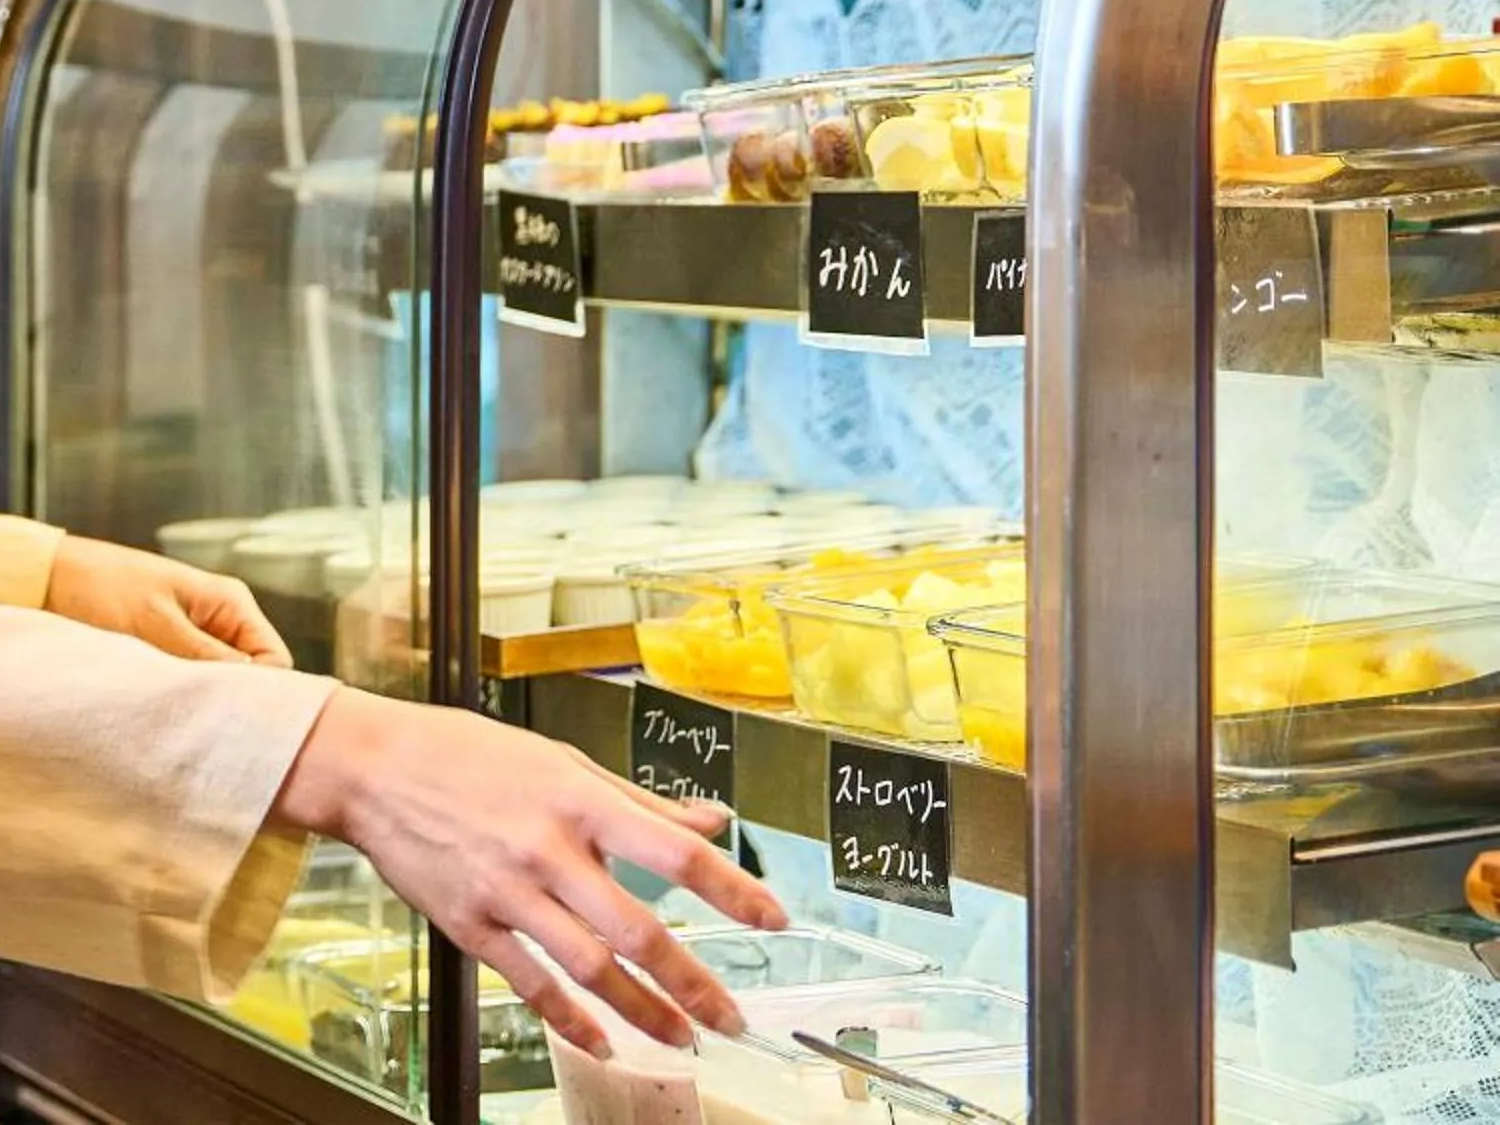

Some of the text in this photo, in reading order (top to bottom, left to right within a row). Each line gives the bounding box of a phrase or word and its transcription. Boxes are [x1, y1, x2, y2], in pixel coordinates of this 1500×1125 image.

[819, 246, 911, 300] みかん
[643, 709, 731, 764] ブルーベリー
[835, 764, 947, 824] ストロベリー
[842, 836, 933, 886] ヨーグルト
